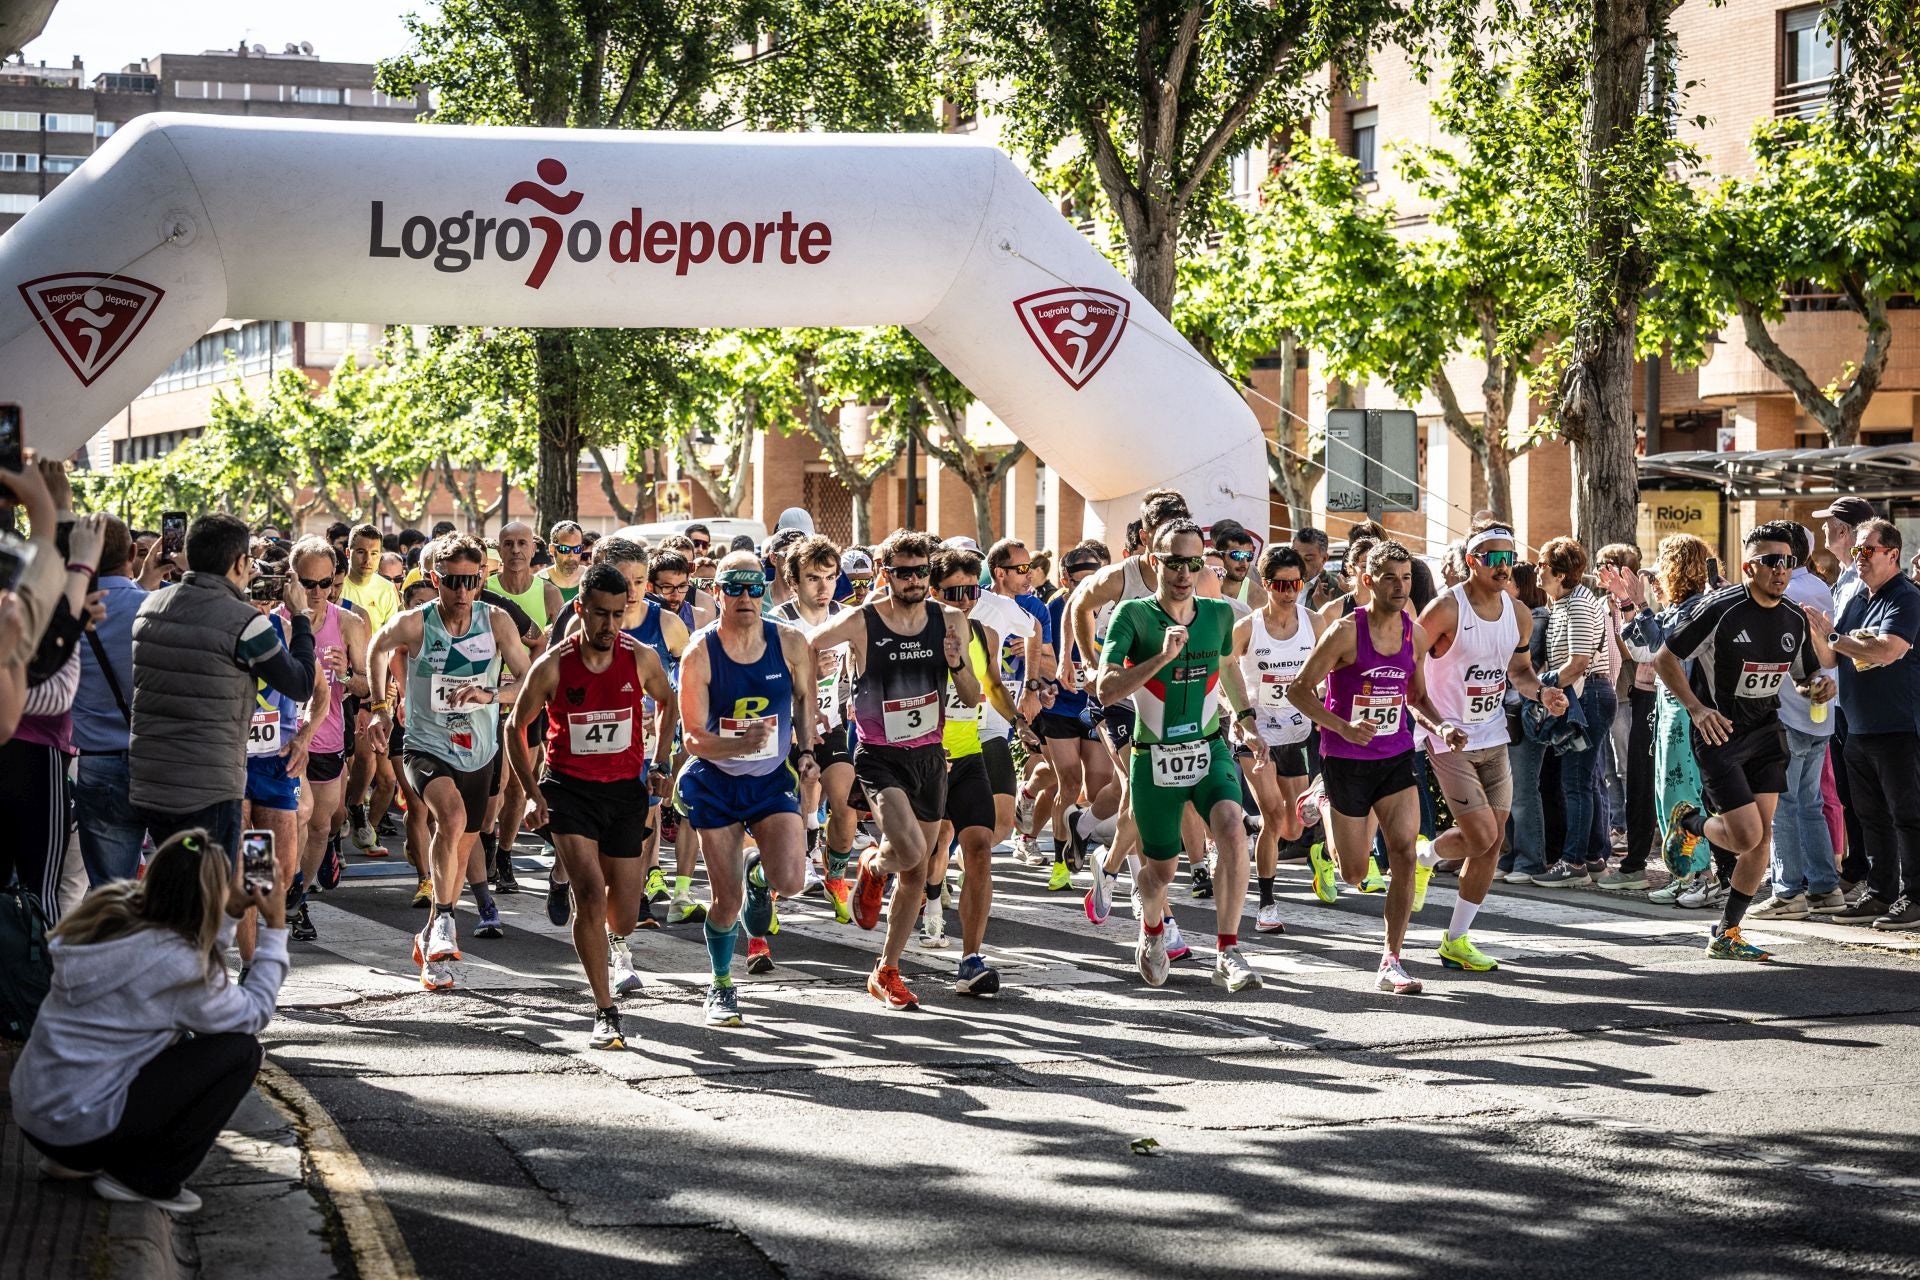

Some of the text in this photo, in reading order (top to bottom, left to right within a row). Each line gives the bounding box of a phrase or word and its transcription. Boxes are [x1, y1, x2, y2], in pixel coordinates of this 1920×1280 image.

[608, 207, 833, 276] deporte
[46, 291, 139, 309] Logroño deporte
[1038, 305, 1115, 318] Logroño deporte
[1657, 505, 1702, 524] Rioja
[1655, 520, 1682, 530] TIVAL
[732, 572, 759, 580] NIKE
[888, 649, 933, 660] O BARCO
[1178, 649, 1219, 662] taNatura
[1744, 673, 1782, 689] 618
[907, 709, 922, 728] 3
[1359, 707, 1398, 725] 156
[249, 724, 275, 743] 40
[585, 723, 619, 743] 47
[1157, 753, 1209, 775] 1075
[1173, 773, 1196, 781] SERGIO
